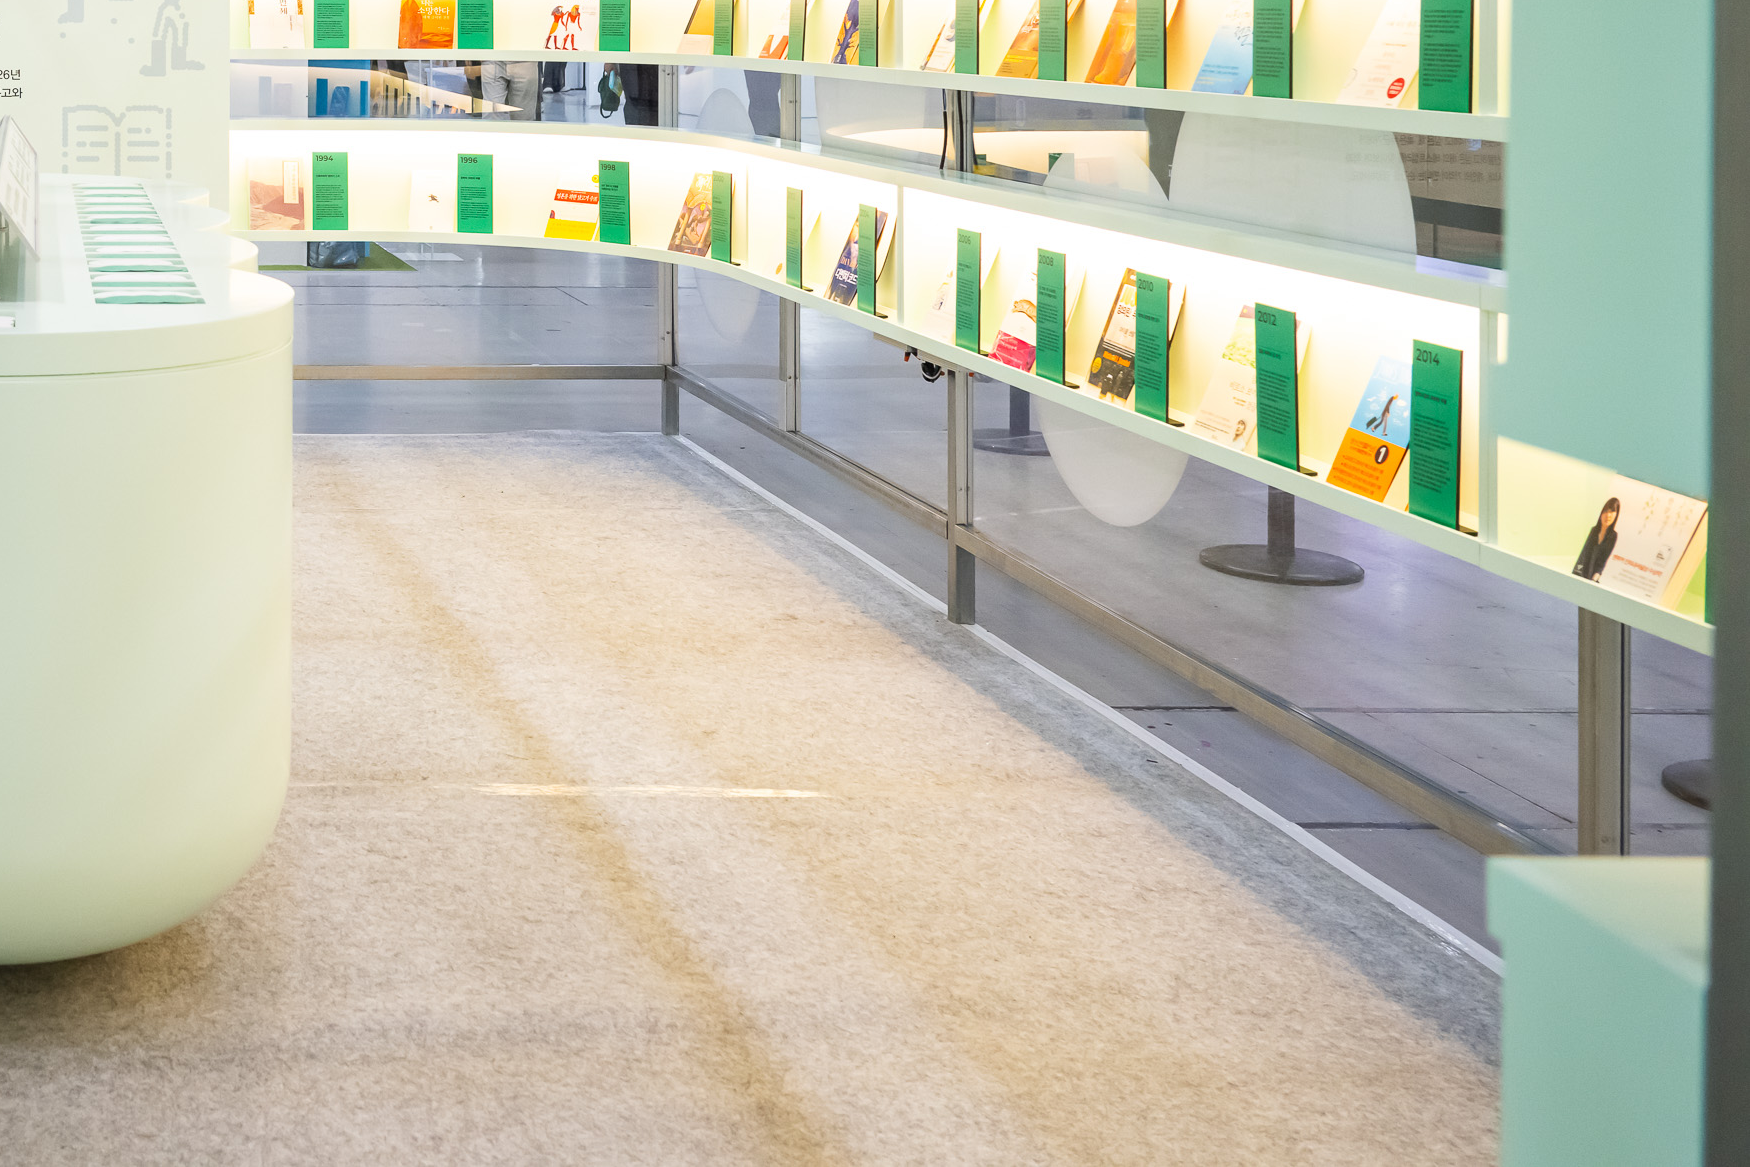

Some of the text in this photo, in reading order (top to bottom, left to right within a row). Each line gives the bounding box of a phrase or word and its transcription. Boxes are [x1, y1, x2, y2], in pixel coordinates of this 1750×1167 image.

[417, 6, 450, 16] 소망한다
[315, 154, 334, 162] 1994
[460, 156, 478, 164] 1996
[1257, 310, 1277, 327] 2012
[1415, 347, 1440, 366] 2014
